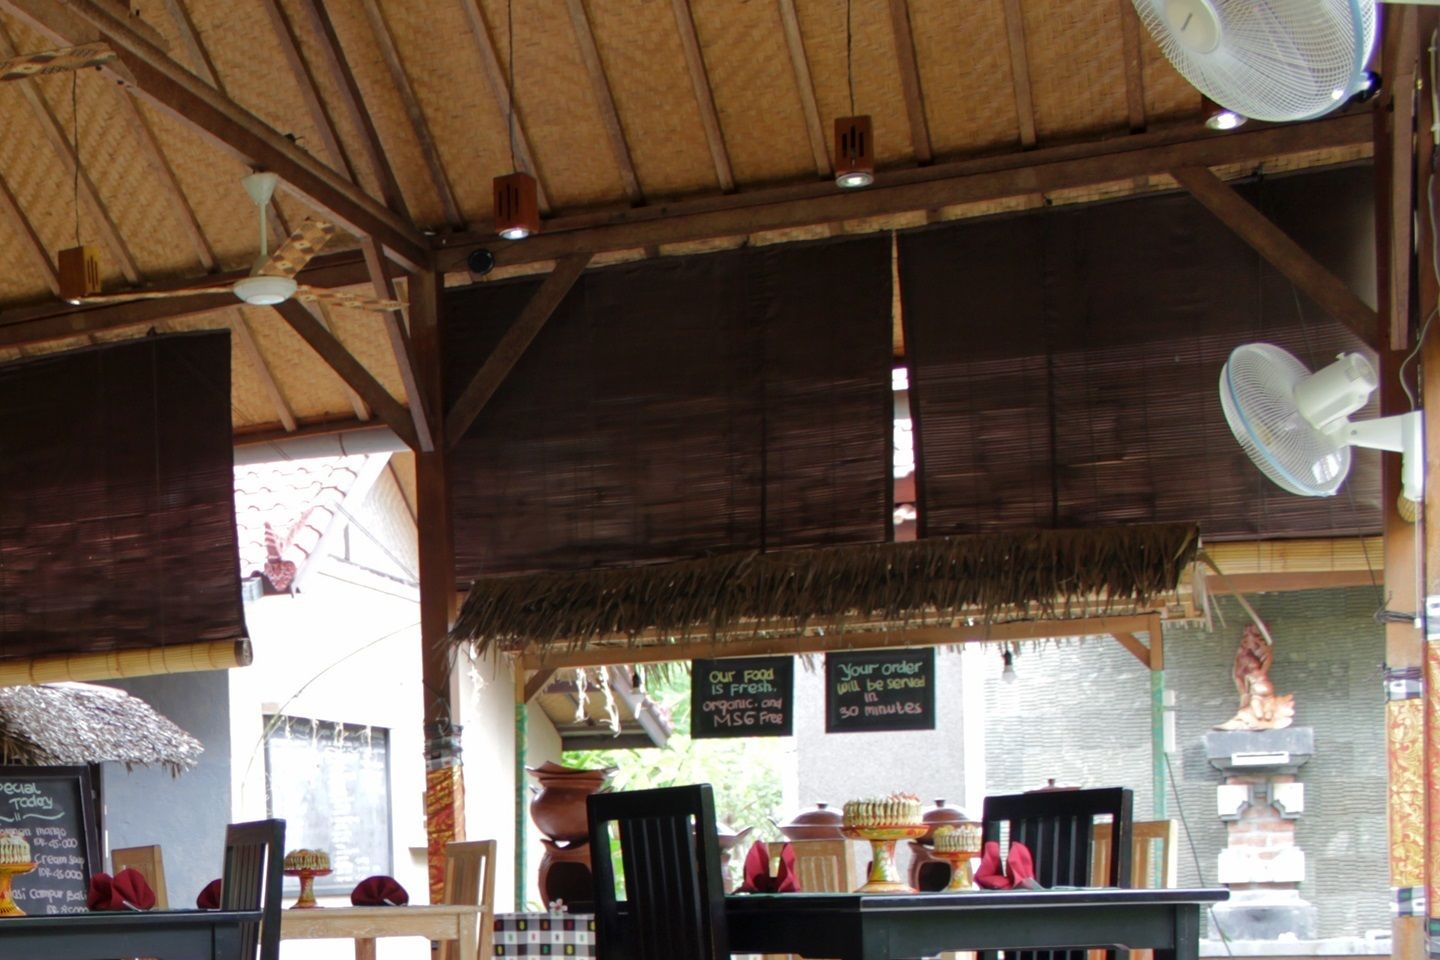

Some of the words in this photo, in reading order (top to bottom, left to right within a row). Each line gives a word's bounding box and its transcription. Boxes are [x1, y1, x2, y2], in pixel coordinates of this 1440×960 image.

[709, 670, 736, 683] Our
[743, 668, 774, 683] Food
[838, 663, 879, 681] Your
[837, 680, 861, 695] will
[866, 678, 884, 692] be
[886, 675, 926, 690] served
[761, 697, 783, 709] and
[839, 705, 859, 719] 30
[864, 701, 923, 717] minutes
[713, 710, 757, 728] MSG
[760, 711, 784, 725] Free
